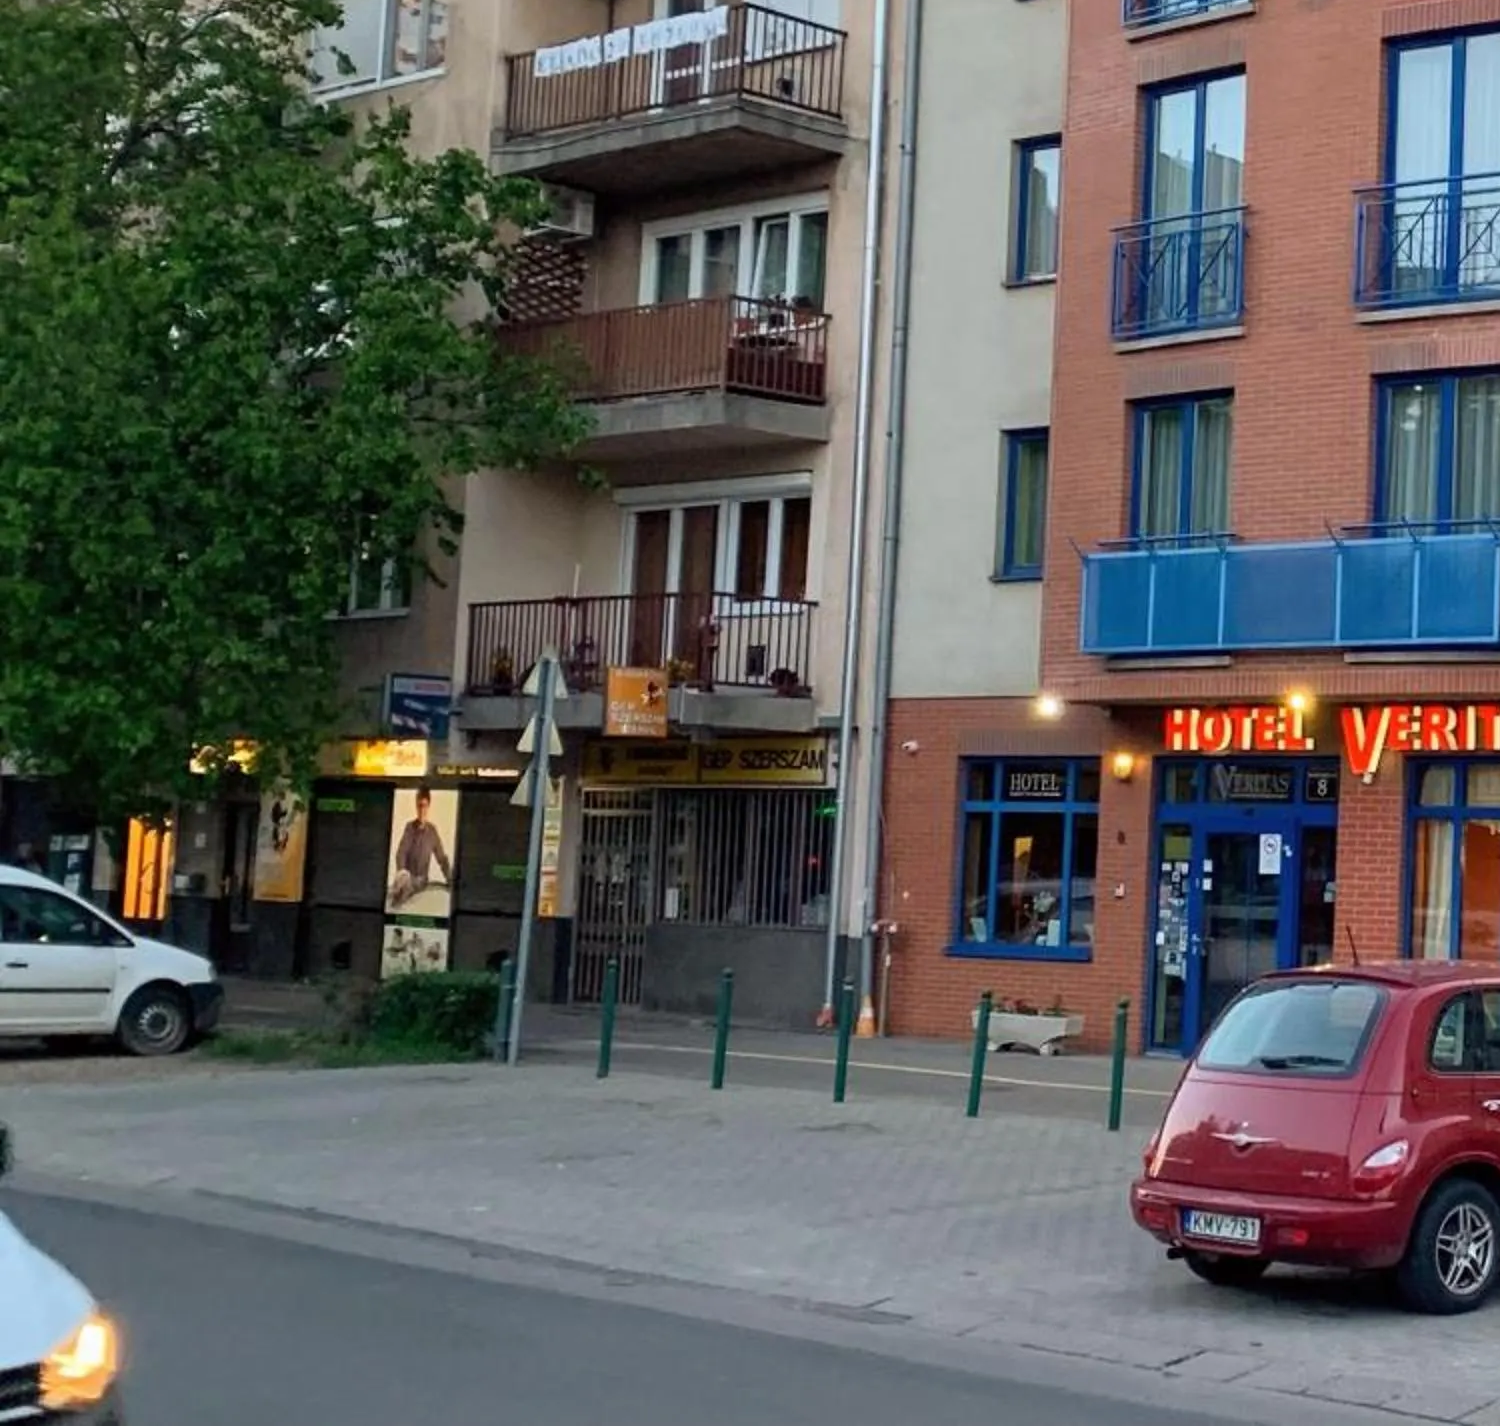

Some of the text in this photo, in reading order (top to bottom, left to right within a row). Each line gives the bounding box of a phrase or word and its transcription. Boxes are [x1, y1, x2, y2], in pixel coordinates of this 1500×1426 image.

[1164, 706, 1315, 752] HOTEL
[1009, 773, 1061, 791] HOTEL
[1211, 763, 1290, 799] VERITAS
[1316, 778, 1329, 798] 8
[1192, 1212, 1257, 1239] KMV-791
